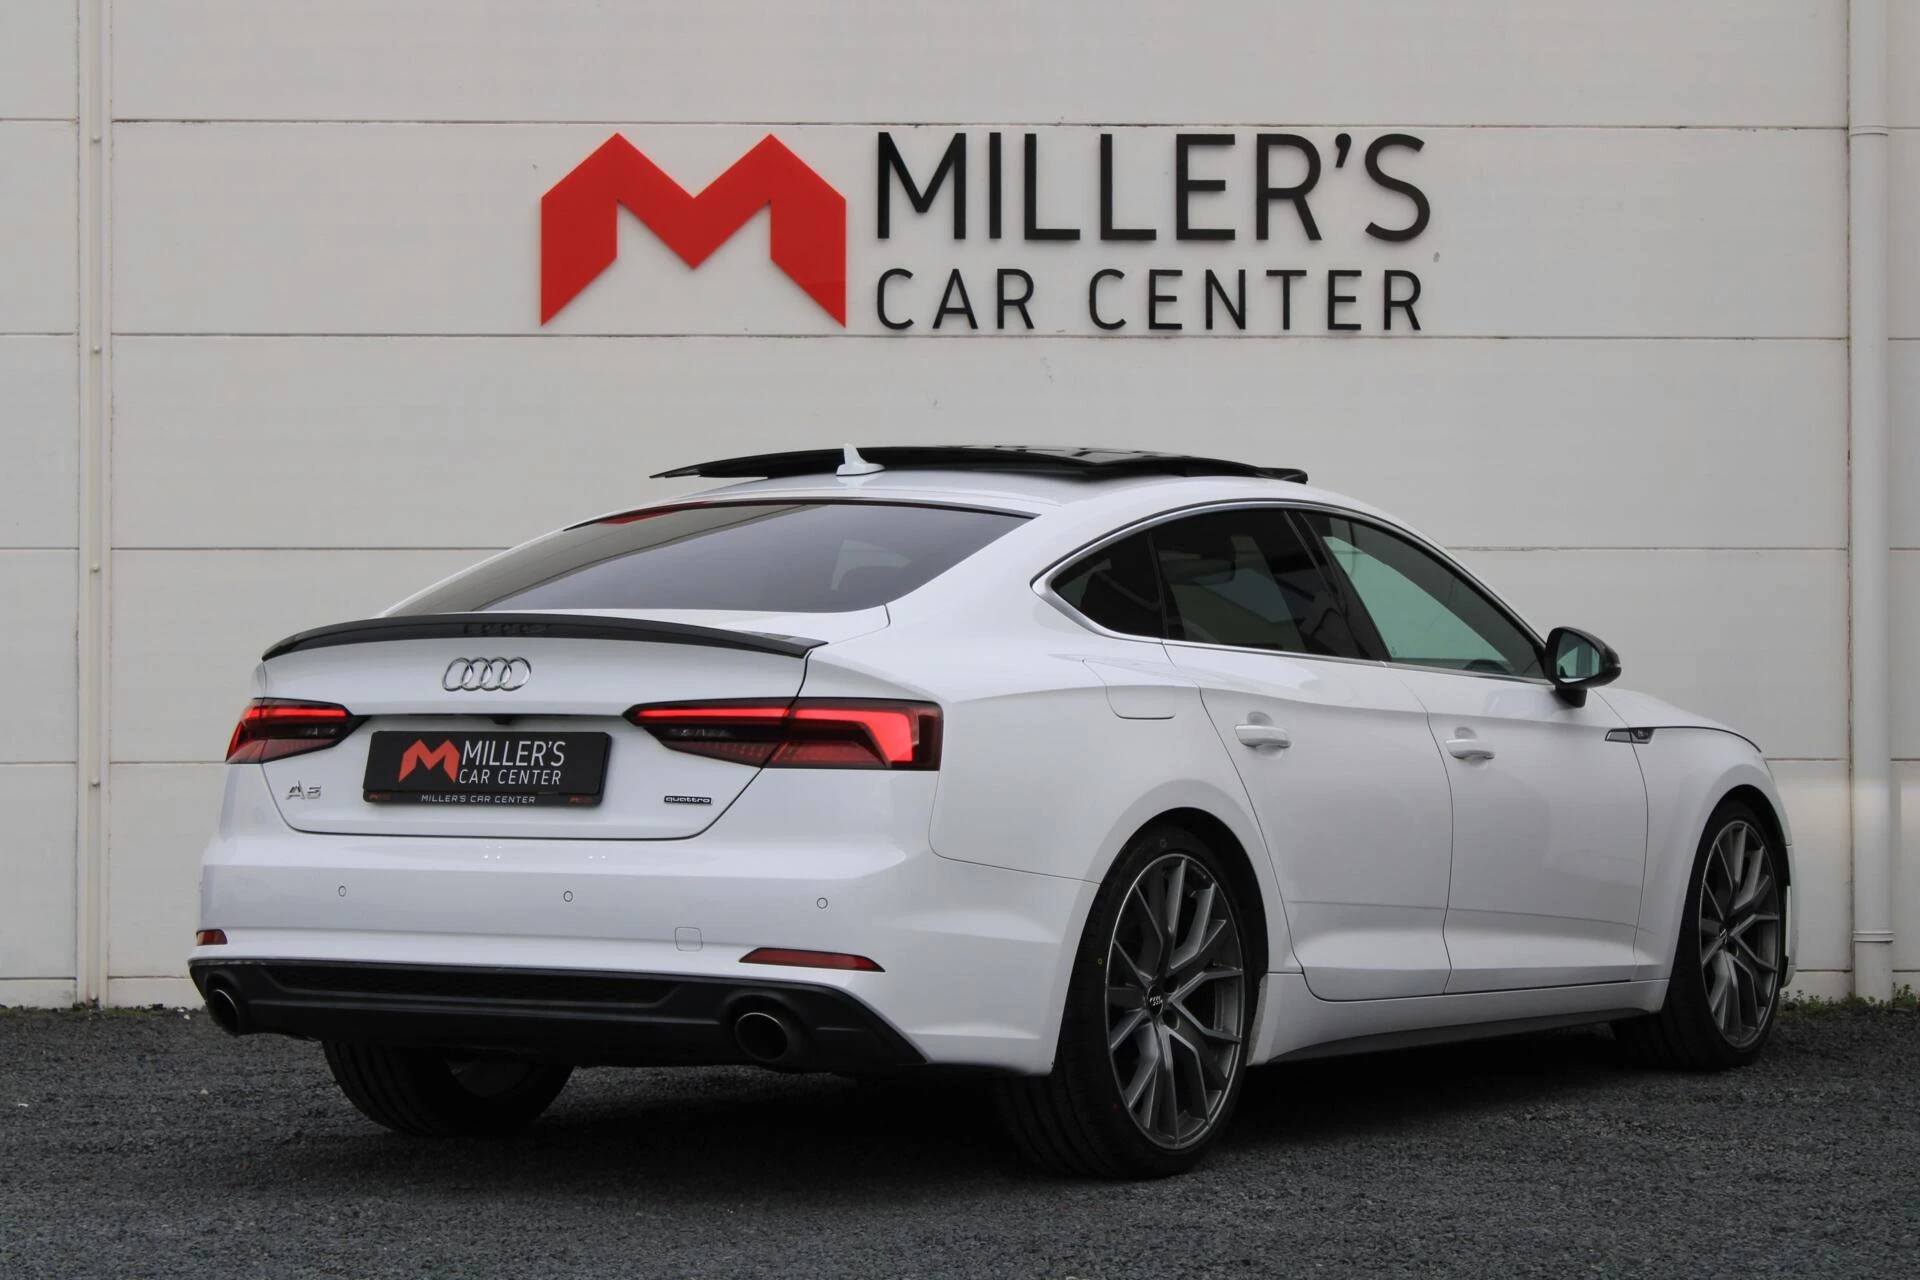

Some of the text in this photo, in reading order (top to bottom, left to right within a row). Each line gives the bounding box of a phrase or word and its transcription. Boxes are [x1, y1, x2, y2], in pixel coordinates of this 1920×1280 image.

[877, 132, 1430, 241] MILLER'S
[877, 269, 1421, 331] CAR CENTER
[462, 740, 566, 766] MILLER'S
[459, 769, 561, 785] CAR CENTER
[286, 780, 321, 800] A5
[470, 795, 491, 803] CAR
[494, 796, 535, 804] CENTER
[664, 796, 711, 804] quattro
